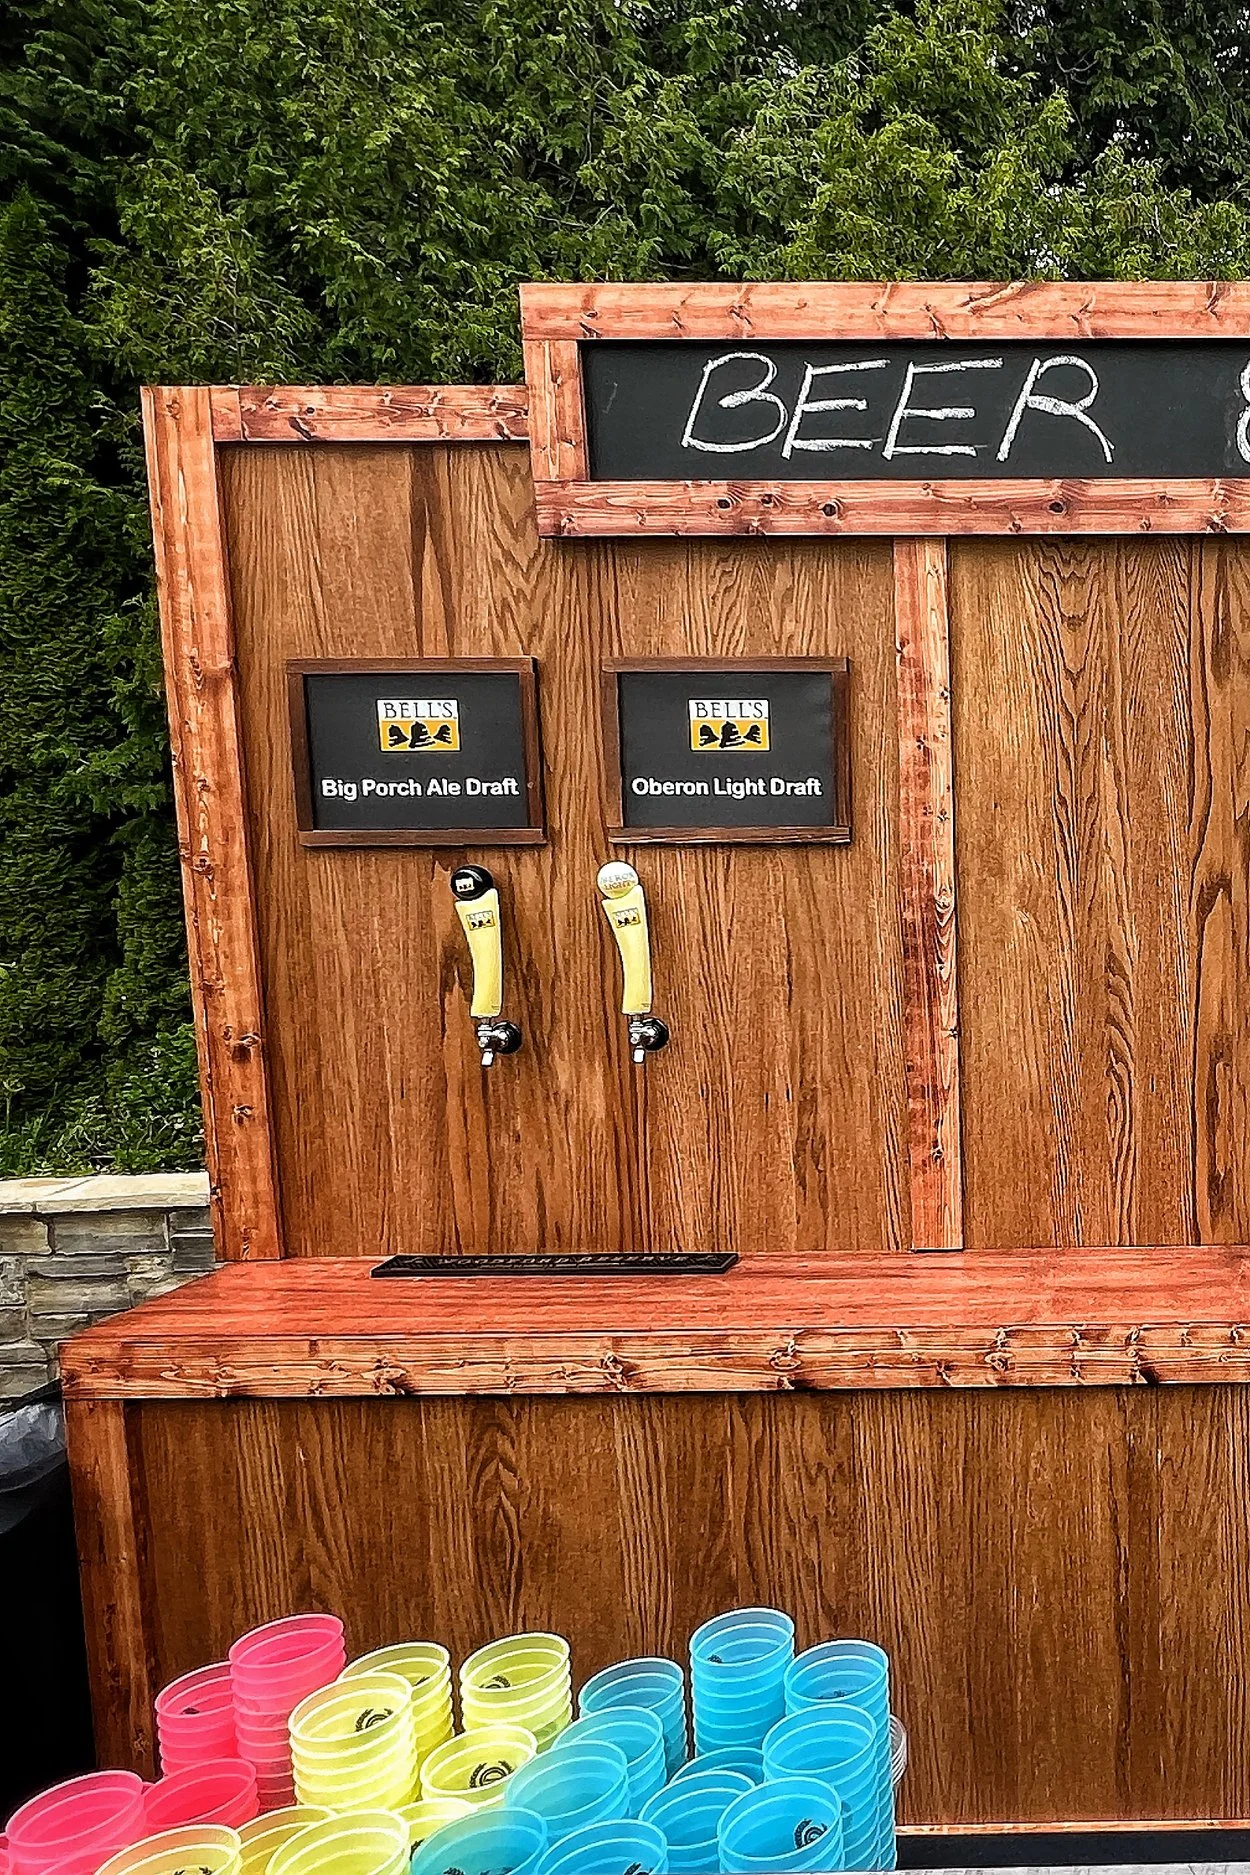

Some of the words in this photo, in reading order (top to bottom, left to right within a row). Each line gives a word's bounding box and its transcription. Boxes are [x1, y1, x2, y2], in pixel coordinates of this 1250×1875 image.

[681, 351, 1115, 463] BEER
[383, 702, 453, 719] BELL'S
[695, 702, 763, 719] BELL'S
[321, 779, 358, 802] Big
[361, 778, 423, 797] Porch
[426, 777, 462, 797] Ale
[465, 777, 520, 796] Draft
[631, 777, 710, 796] Oberon
[713, 777, 768, 800] Light
[769, 777, 823, 796] Draft
